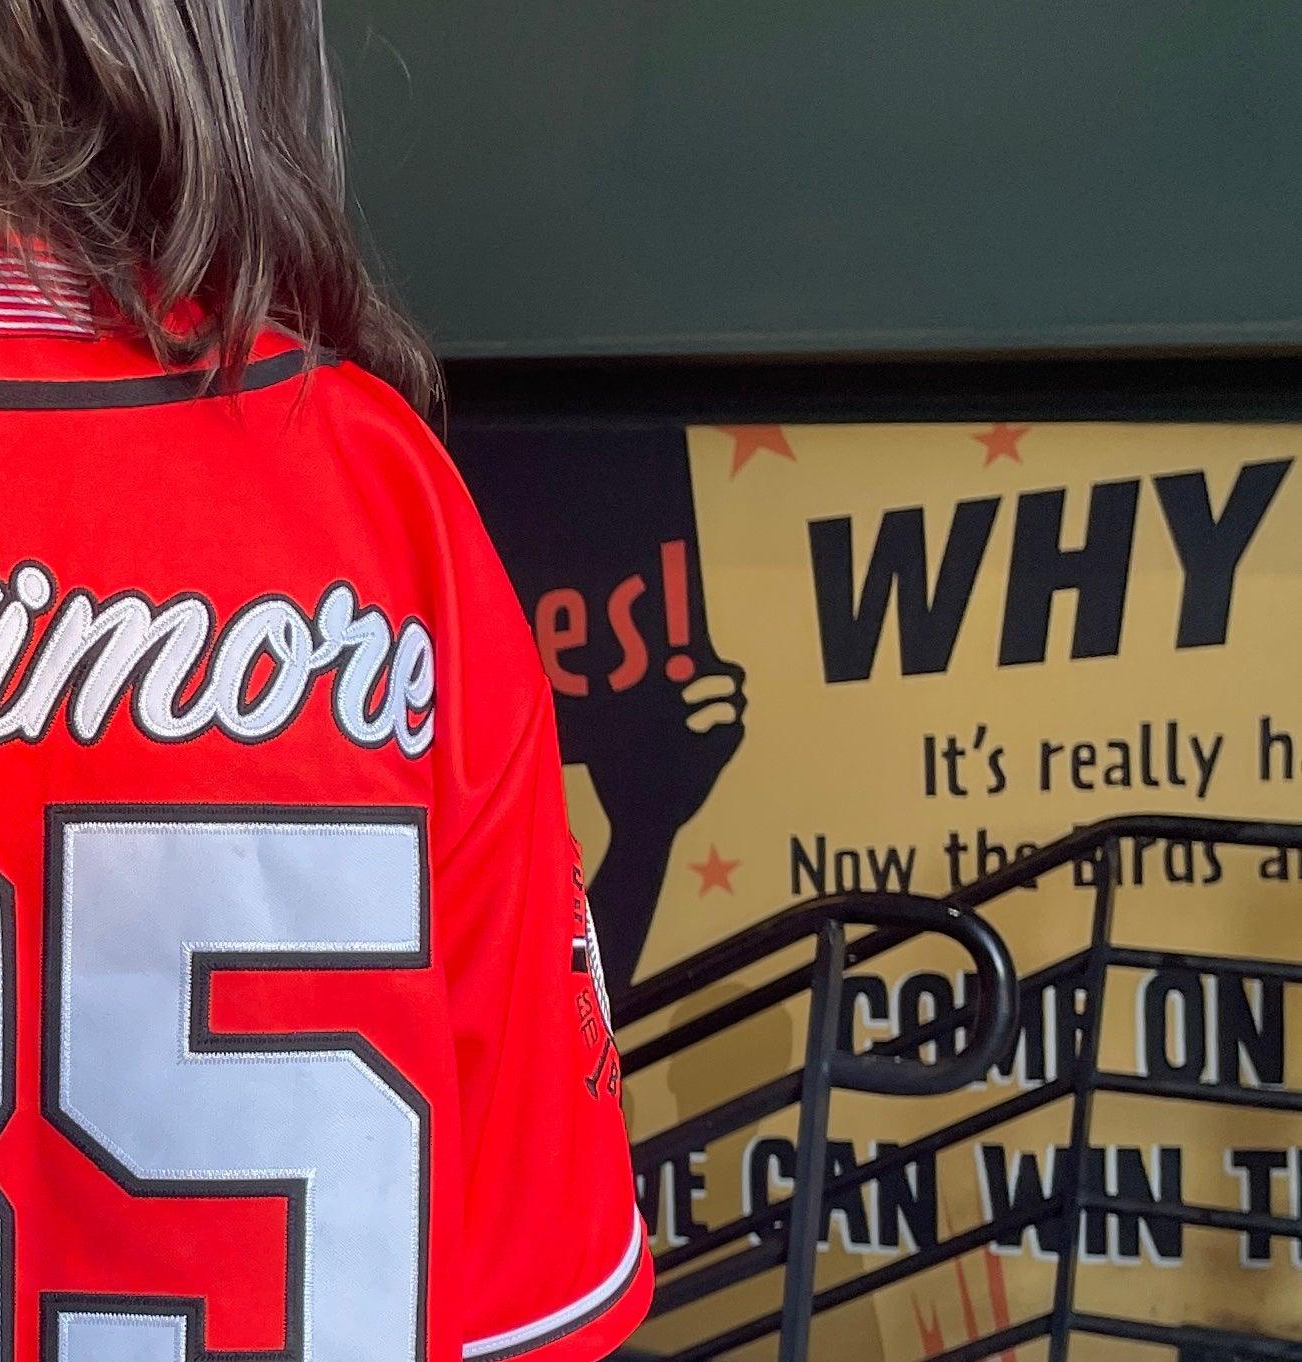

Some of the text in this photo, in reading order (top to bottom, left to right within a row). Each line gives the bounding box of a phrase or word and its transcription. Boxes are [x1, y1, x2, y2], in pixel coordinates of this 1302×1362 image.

[807, 456, 1295, 683] WHY
[923, 714, 1302, 799] It's really h
[790, 832, 917, 895] Now
[1259, 842, 1302, 882] a
[1135, 966, 1286, 1092] ON
[741, 1134, 940, 1256] CAN
[975, 1142, 1185, 1268] WIN
[1223, 1145, 1302, 1268] T
